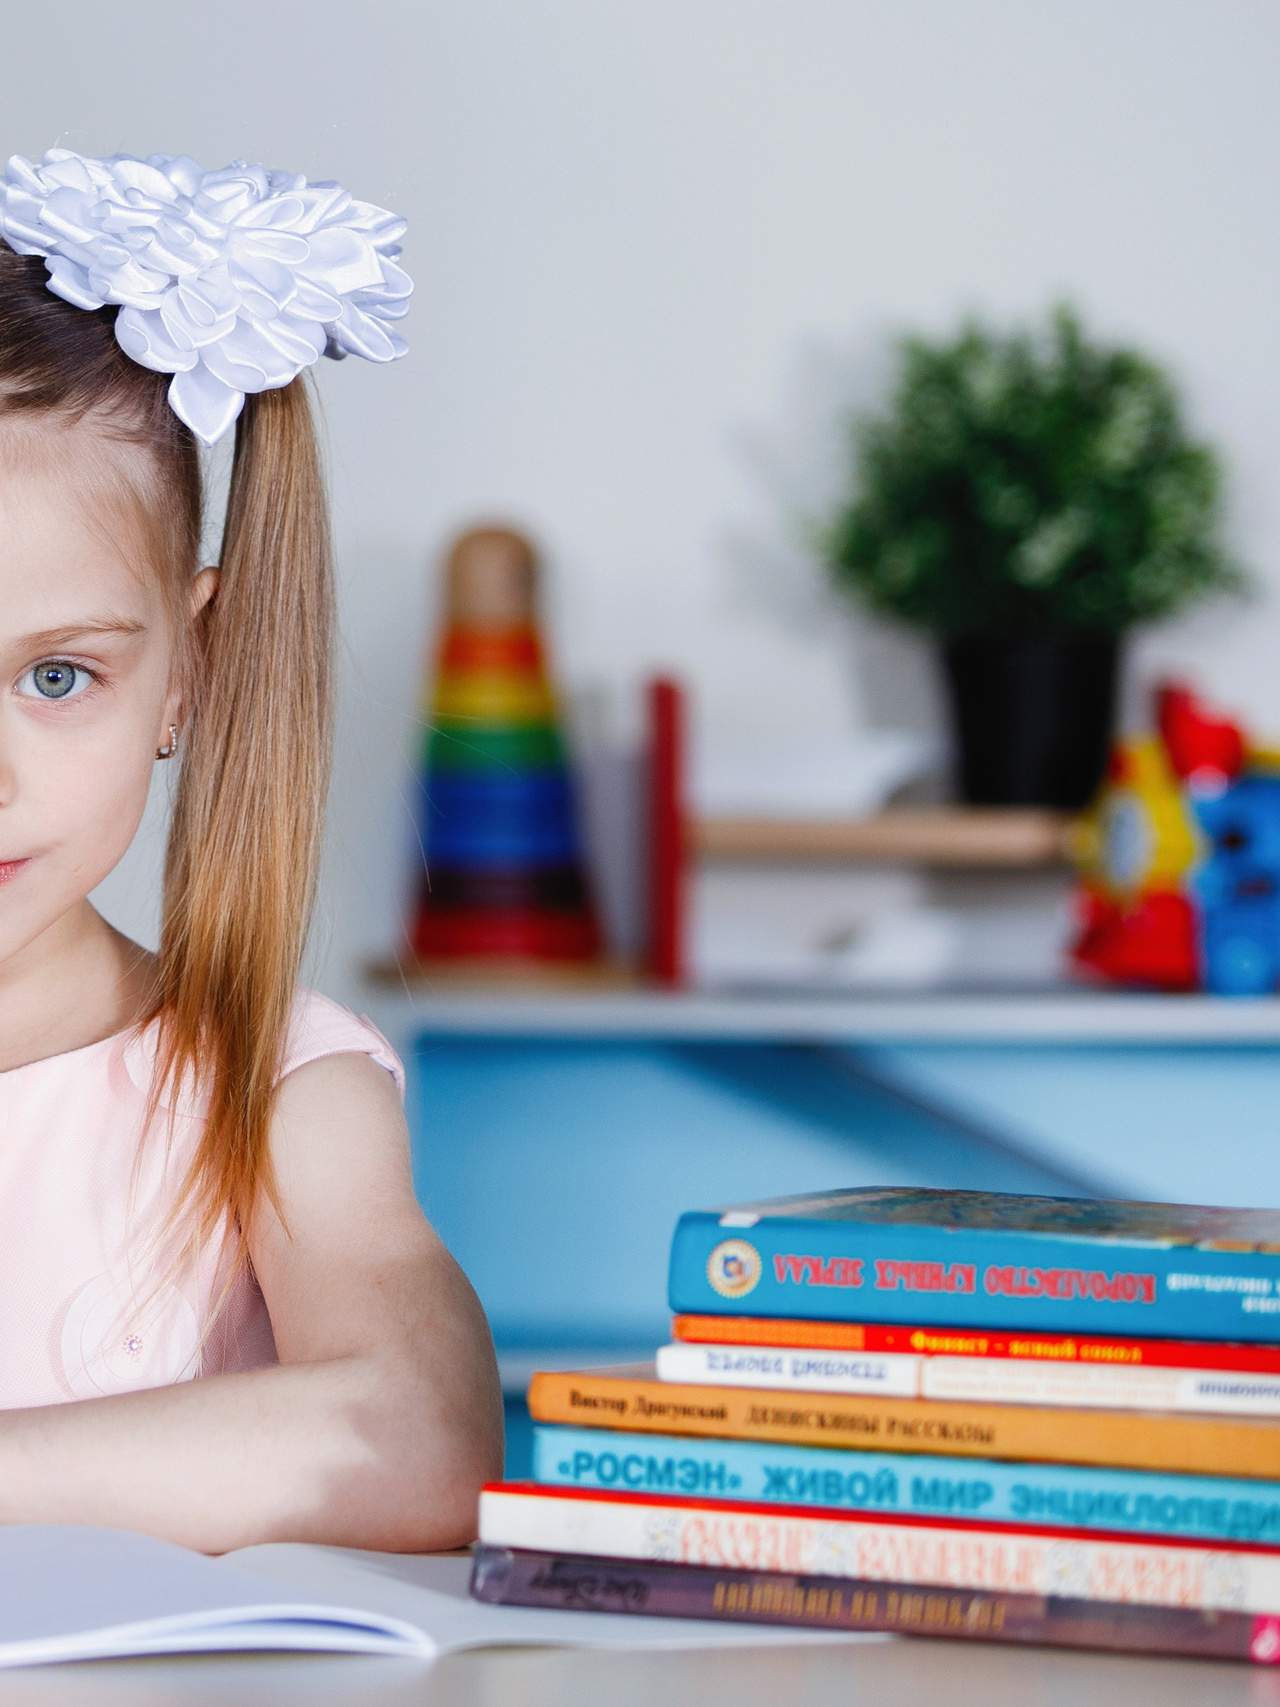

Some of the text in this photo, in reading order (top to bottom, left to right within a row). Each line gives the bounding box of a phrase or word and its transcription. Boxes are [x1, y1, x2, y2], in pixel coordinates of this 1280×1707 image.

[773, 1254, 1156, 1304] КОРОЛЕВСТВО КРИВЫХ ЗЕРКАЛ
[570, 1390, 995, 1445] Виктор Драгунский ДЕНИСКИНЫ РАССКАЗЫ
[762, 1465, 899, 1505] ЖИВОЙ
[910, 1477, 994, 1510] МИР
